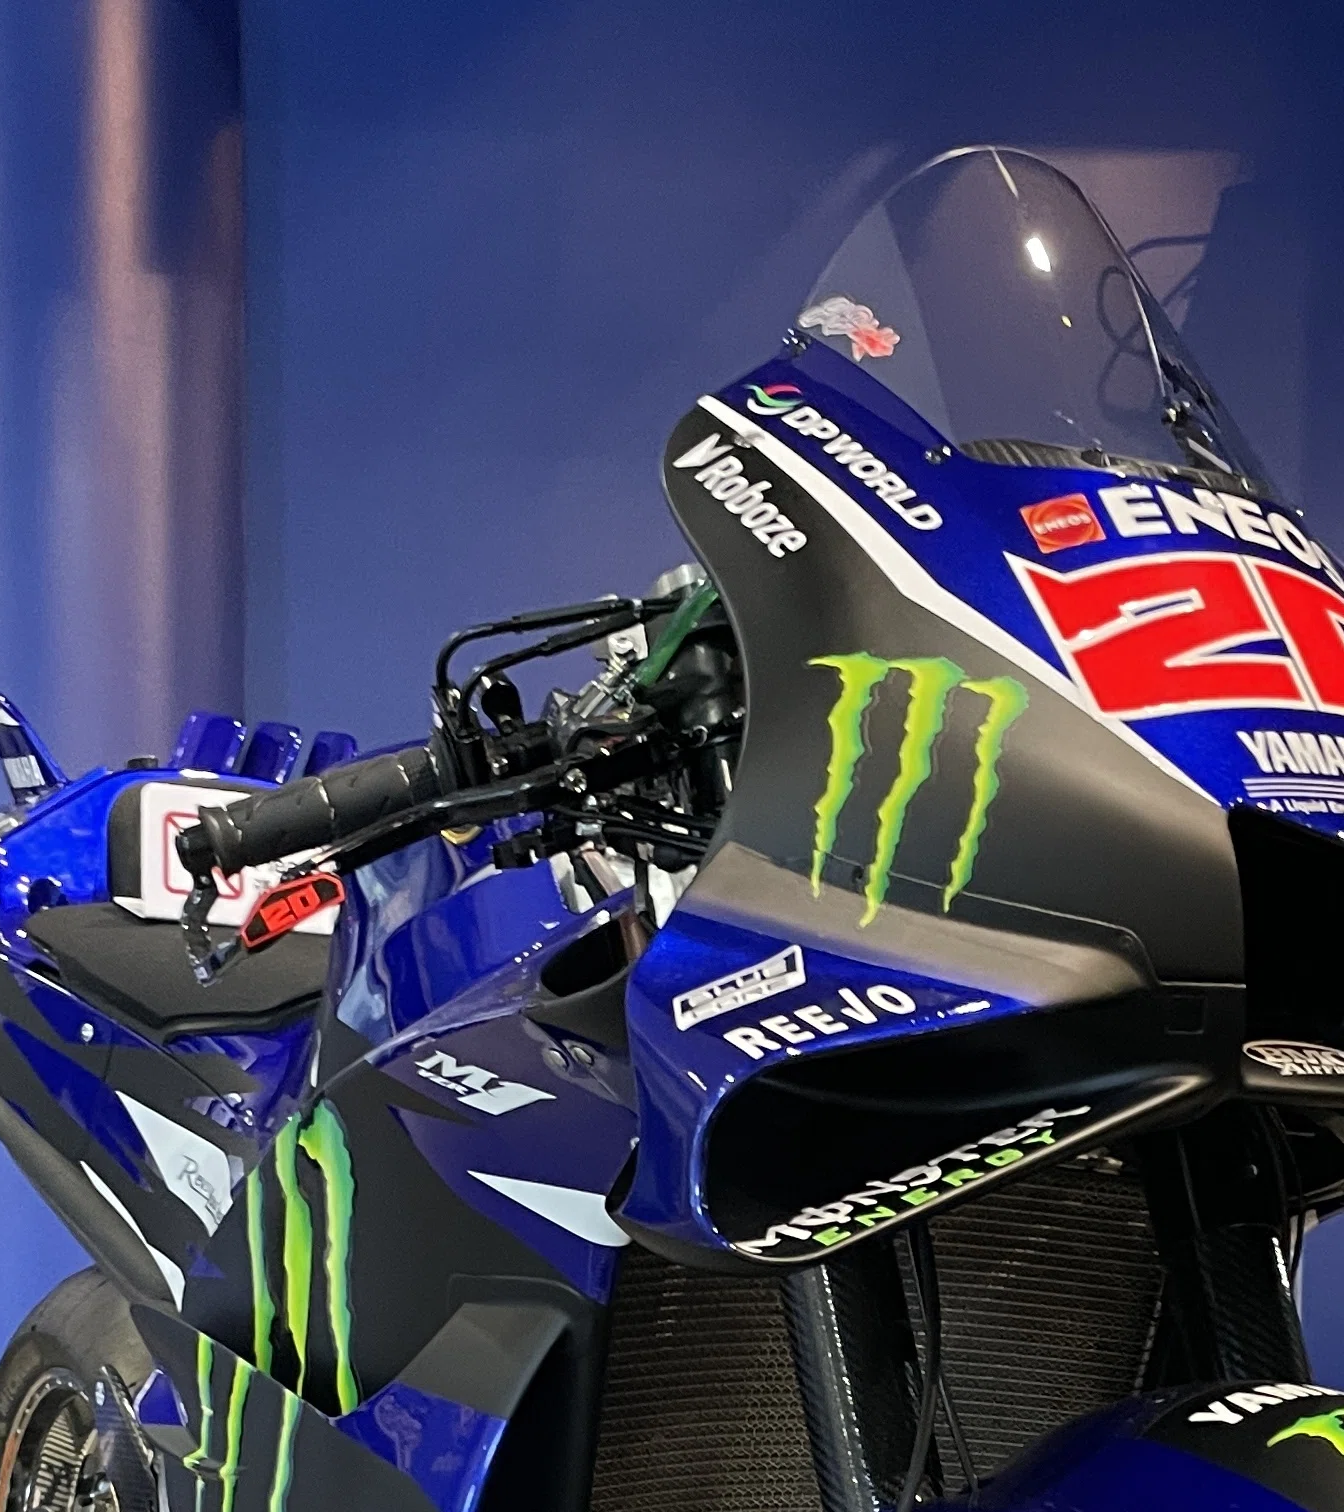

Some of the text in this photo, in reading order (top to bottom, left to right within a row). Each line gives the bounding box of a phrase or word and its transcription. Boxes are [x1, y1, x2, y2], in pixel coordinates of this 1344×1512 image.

[694, 455, 808, 558] Roboze
[822, 433, 943, 530] WORLD
[1032, 511, 1092, 536] ENEOS
[259, 882, 322, 933] 20
[812, 1128, 1056, 1247] ENERGY
